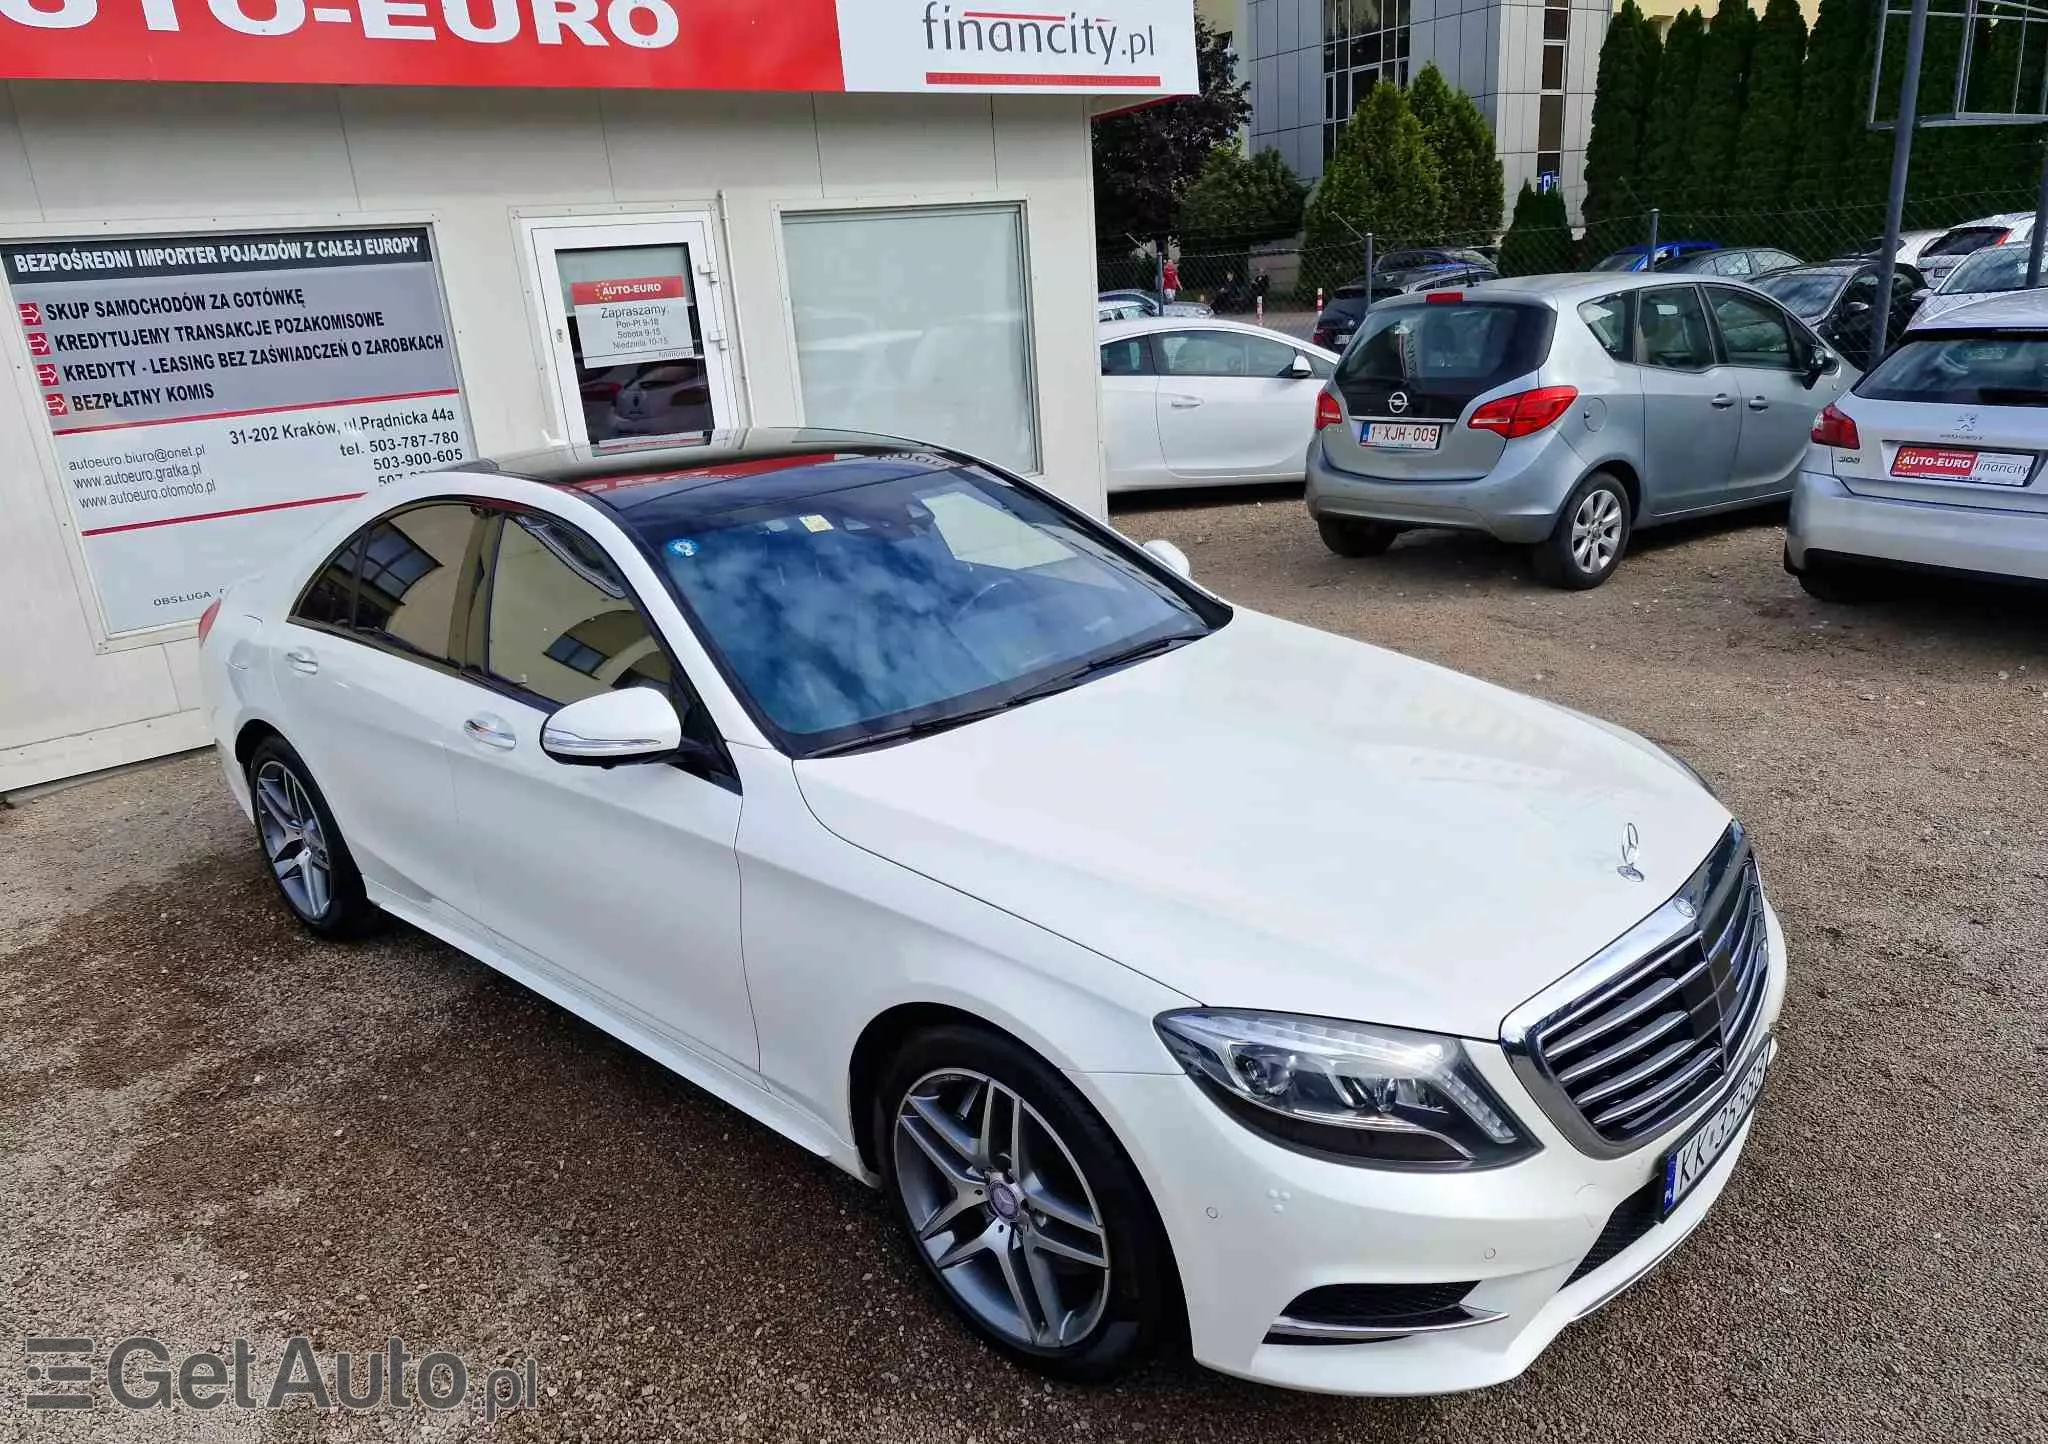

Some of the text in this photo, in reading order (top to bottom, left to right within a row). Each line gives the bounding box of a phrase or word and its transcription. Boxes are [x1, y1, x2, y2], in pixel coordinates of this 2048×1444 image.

[922, 1, 1155, 65] financity.pl
[14, 237, 419, 273] BEZPOŚREDNI IMPORTER POJAZDÓW Z CAŁEJ EUROPY
[45, 287, 306, 320] SKUP SAMOCHODÓW ZA GOTÓWKĘ
[602, 283, 662, 295] AUTO-EURO
[54, 312, 385, 351] KREDYTUJEMY TRANSAKCJE POZAKOMISOWE
[63, 360, 136, 382] KREDYTY
[150, 353, 215, 374] LEASING
[218, 351, 248, 368] BEZ
[251, 338, 349, 365] ZAŚWIADCZEŃ
[352, 341, 362, 356] O
[365, 335, 444, 355] ZAROBKACH
[72, 383, 215, 411] BEZPŁATNY KOMIS
[229, 407, 455, 445] 31-202 Kraków, ul.Prądnicka 44a
[69, 443, 206, 471] autoeuro.biuro@onet.pl
[340, 430, 459, 456] tel. 503-787-780
[373, 448, 463, 470] 503-900-605
[1903, 455, 1971, 468] AUTO-EURO
[73, 462, 202, 489] www.autoeuro.gratka.pl
[79, 479, 216, 509] www.autoeuro.otomoto.pl
[1680, 1125, 1709, 1191] KK
